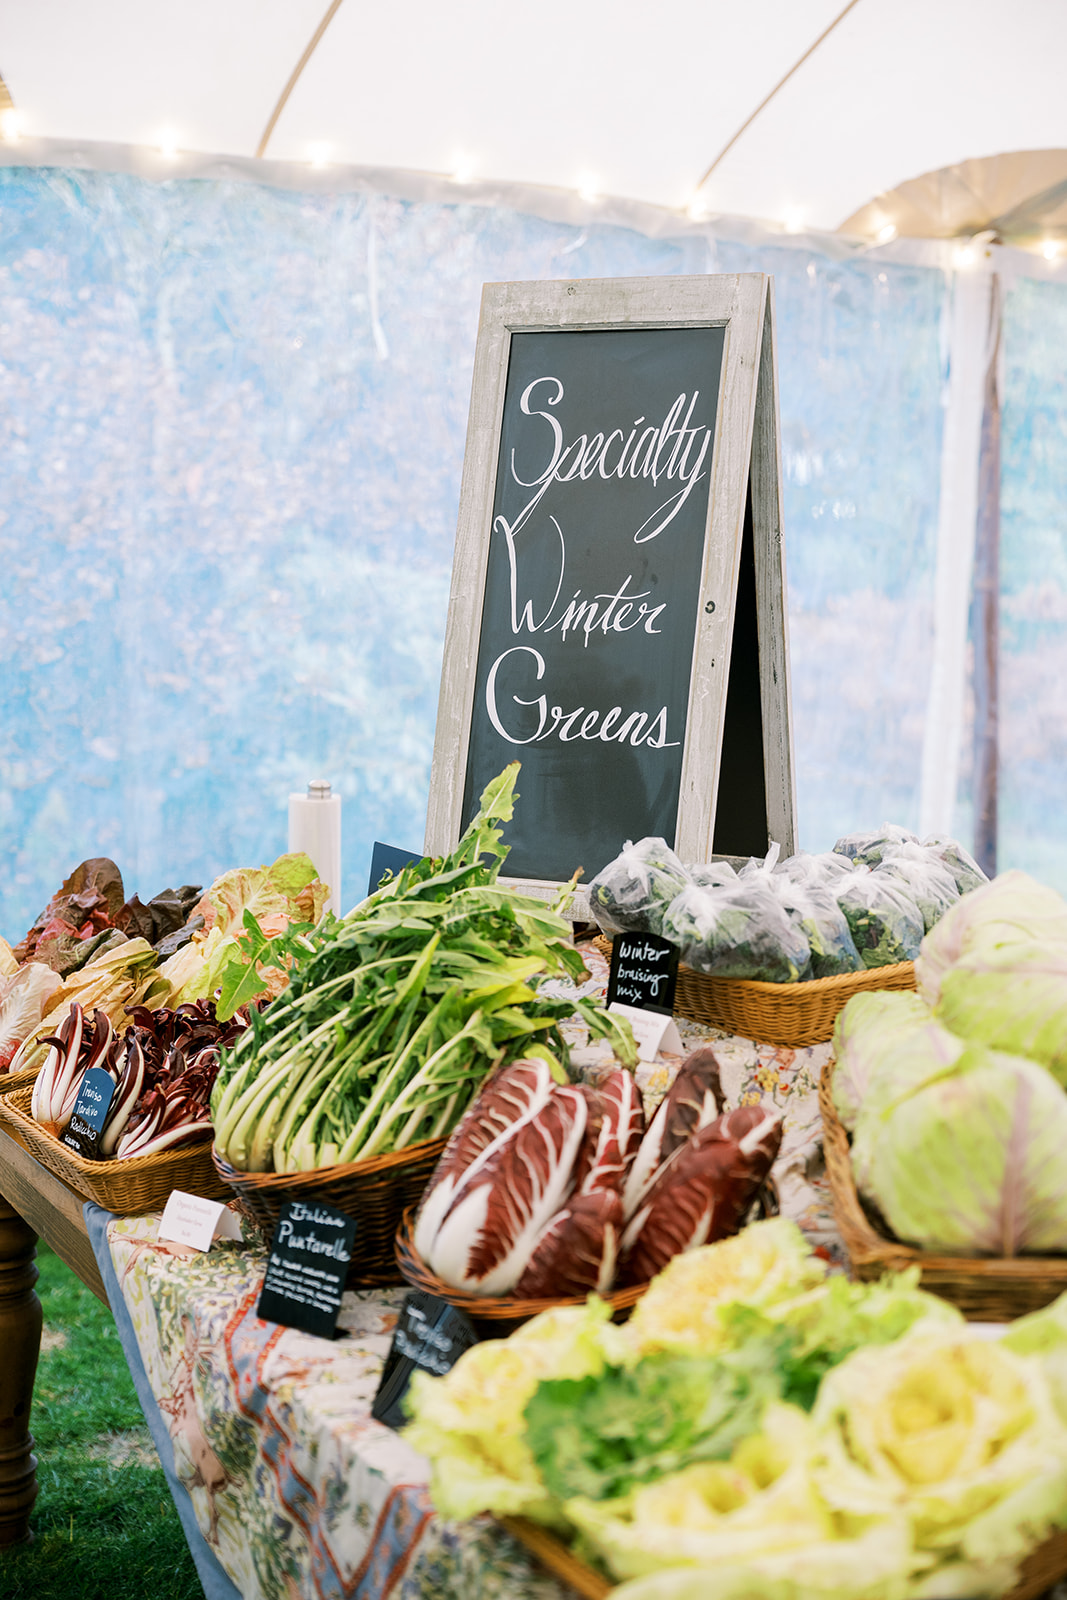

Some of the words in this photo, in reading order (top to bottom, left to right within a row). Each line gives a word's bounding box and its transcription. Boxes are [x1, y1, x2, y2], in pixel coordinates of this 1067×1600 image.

[510, 377, 712, 544] Specialty
[494, 515, 667, 643] Winter
[486, 646, 680, 747] Greens
[616, 984, 642, 1003] mix
[617, 963, 669, 996] braising
